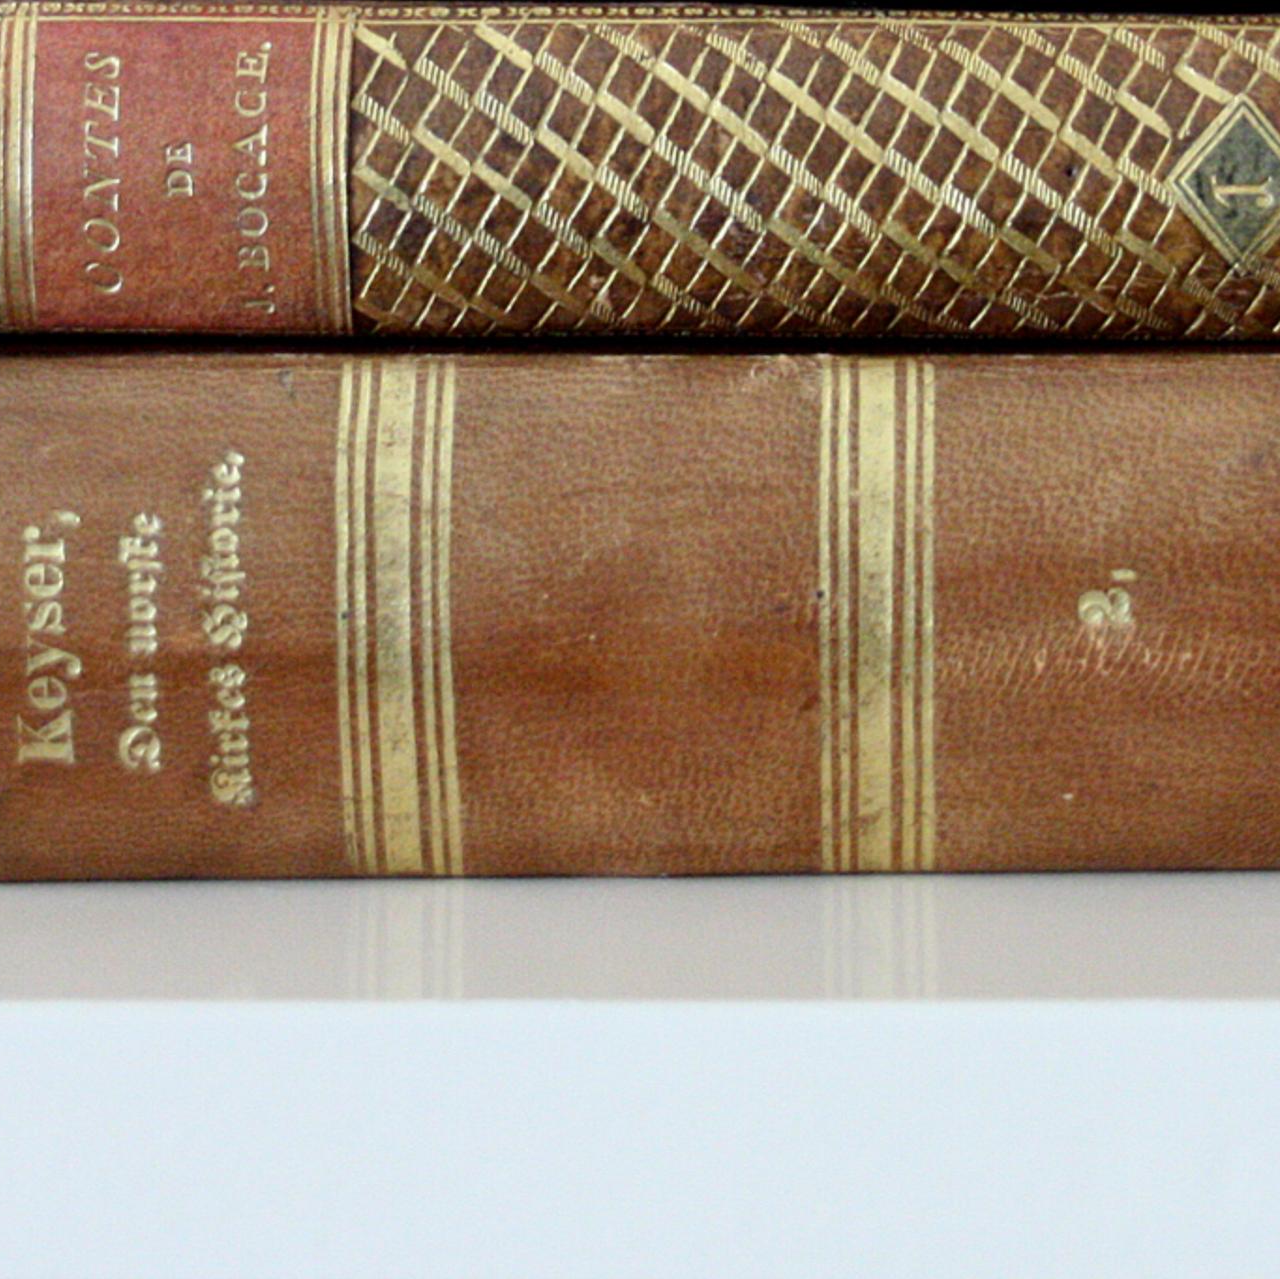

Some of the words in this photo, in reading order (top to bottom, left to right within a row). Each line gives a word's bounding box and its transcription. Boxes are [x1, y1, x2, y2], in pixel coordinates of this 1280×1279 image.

[82, 50, 123, 294] CONTES
[166, 141, 194, 197] DE
[234, 40, 272, 271] BOCACE.
[16, 510, 82, 765] Keyser,
[117, 673, 162, 771] Den
